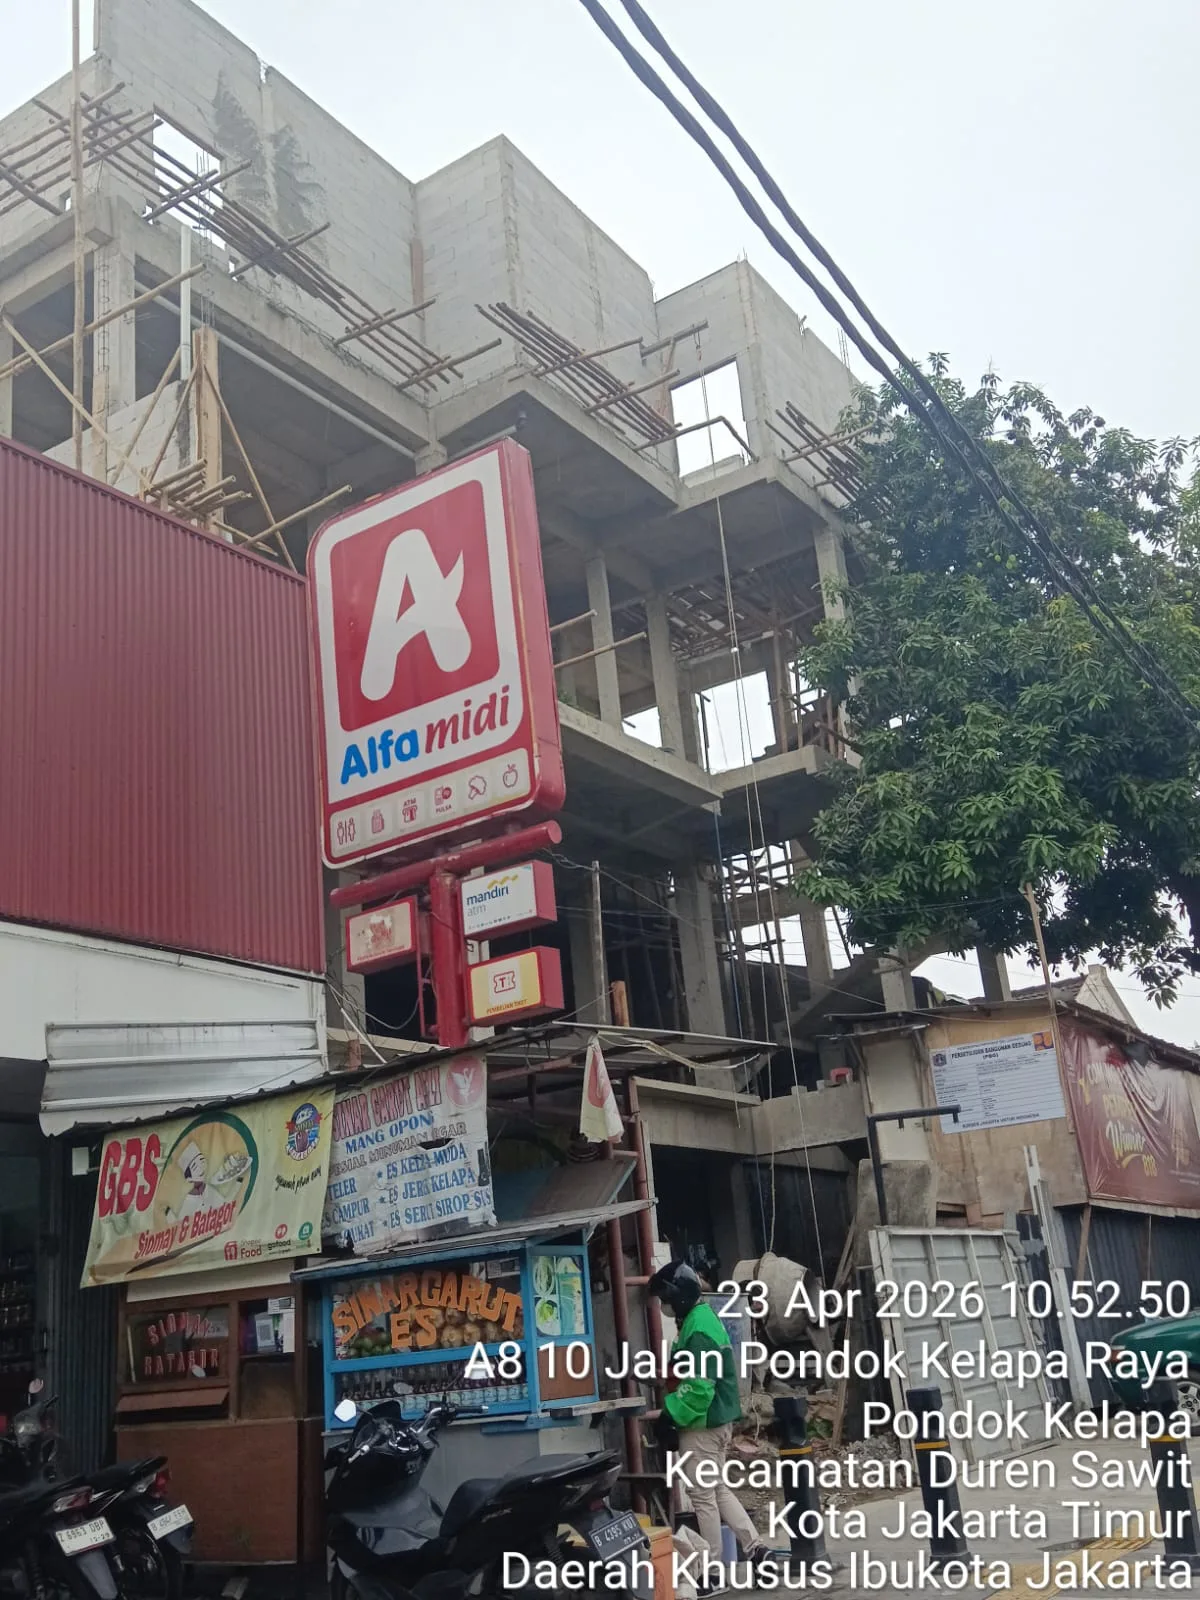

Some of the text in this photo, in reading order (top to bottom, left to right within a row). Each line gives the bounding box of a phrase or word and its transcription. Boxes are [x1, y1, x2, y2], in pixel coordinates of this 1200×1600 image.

[466, 885, 509, 906] mandiri
[467, 904, 487, 917] atm
[345, 1129, 385, 1155] MANG
[98, 1133, 160, 1218] GBS
[386, 1161, 398, 1180] ES
[433, 1142, 467, 1167] MUDA
[332, 1197, 370, 1225] CAMPUR
[389, 1184, 399, 1204] ES
[431, 1167, 476, 1193] KELAPA
[390, 1210, 401, 1229] ES
[435, 1193, 470, 1217] SIROP
[134, 1200, 237, 1260] Siomay & Batagor
[240, 1245, 262, 1259] Food
[390, 1307, 438, 1349] ES
[594, 1535, 603, 1547] B
